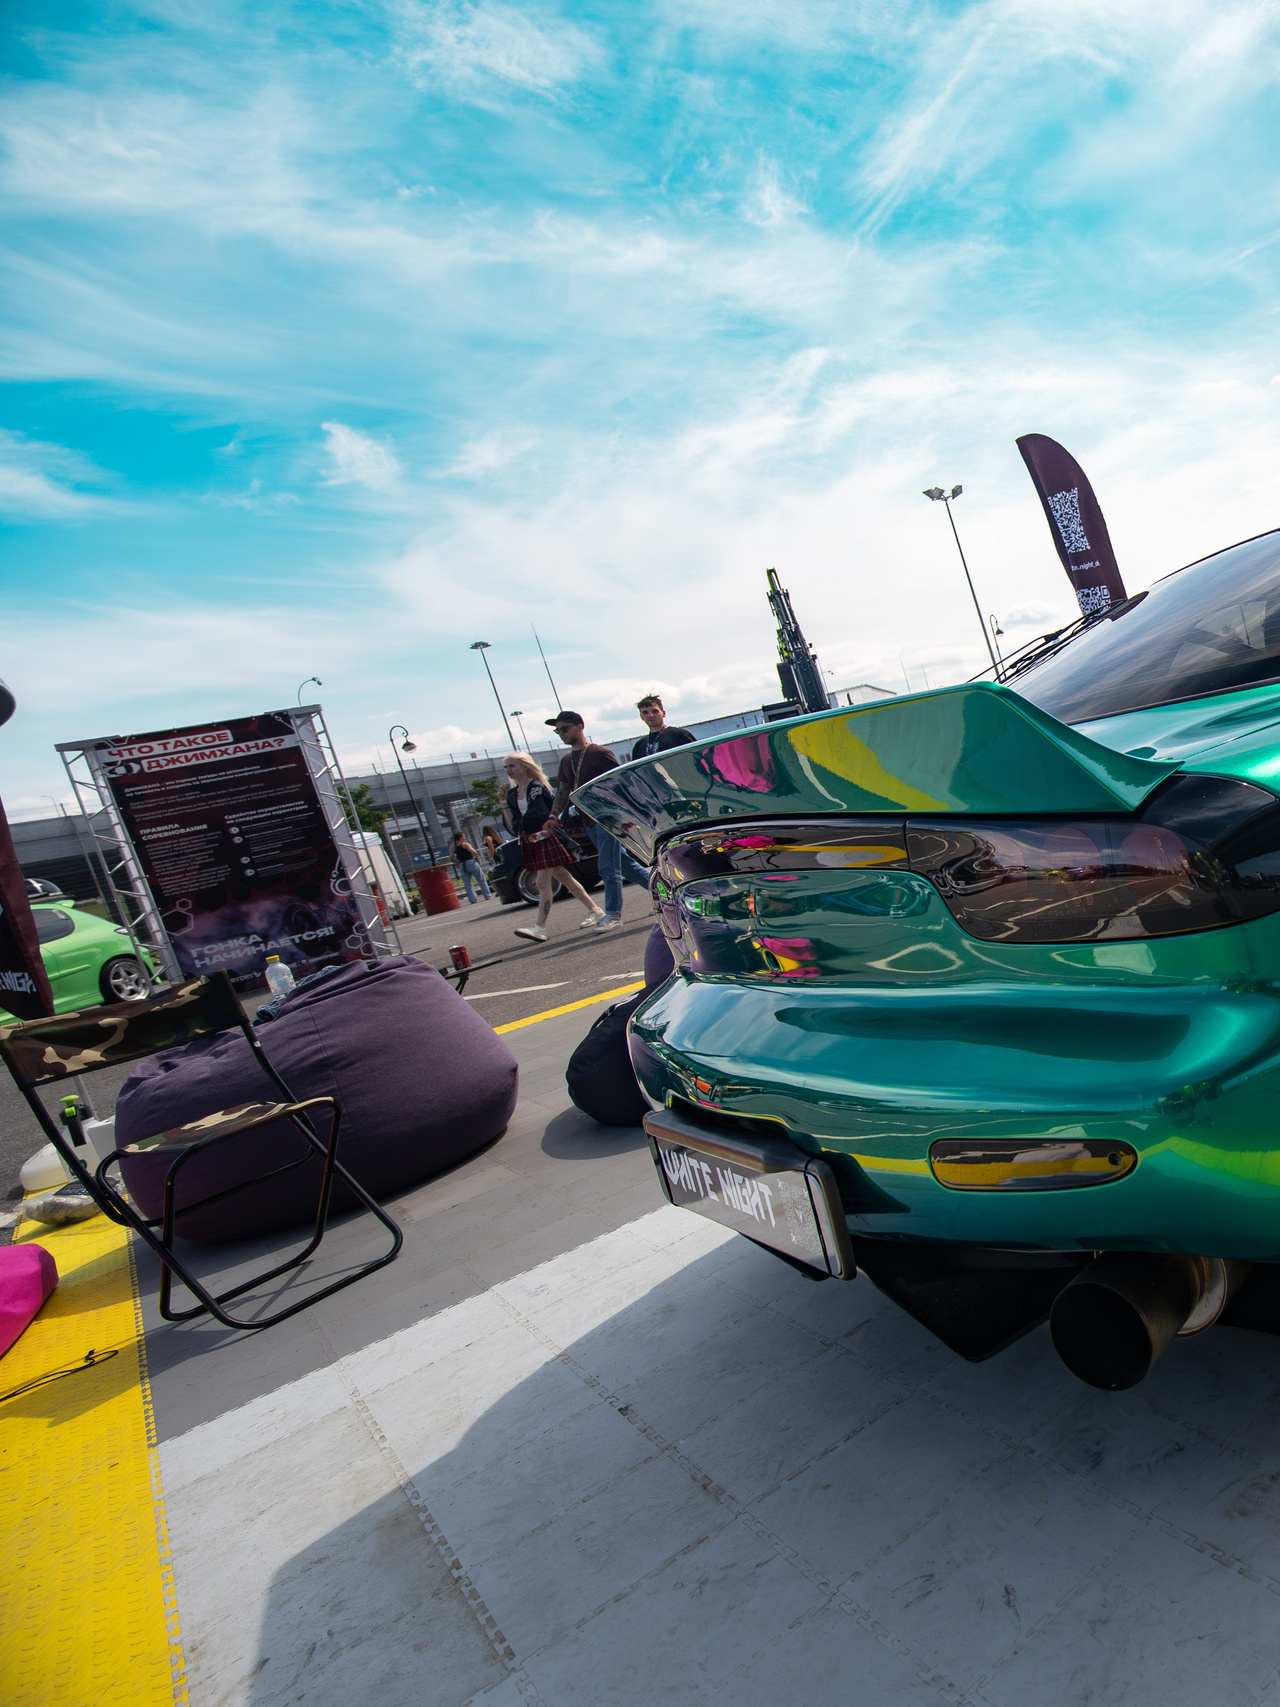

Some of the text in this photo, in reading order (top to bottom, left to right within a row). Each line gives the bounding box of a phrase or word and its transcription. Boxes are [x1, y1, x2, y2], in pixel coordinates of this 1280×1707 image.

[108, 732, 230, 758] ЧТО ТАКОЕ
[146, 738, 285, 770] ДЖИМХАНА?
[140, 823, 180, 835] ПРАВИЛА
[142, 824, 208, 840] СОРЕВНОВАНИЯ
[190, 934, 263, 957] ГОНКА
[195, 926, 335, 968] НАЧИНАЕТСЯ!
[230, 973, 254, 983] RYDRY
[716, 1166, 776, 1228] NIGHT
